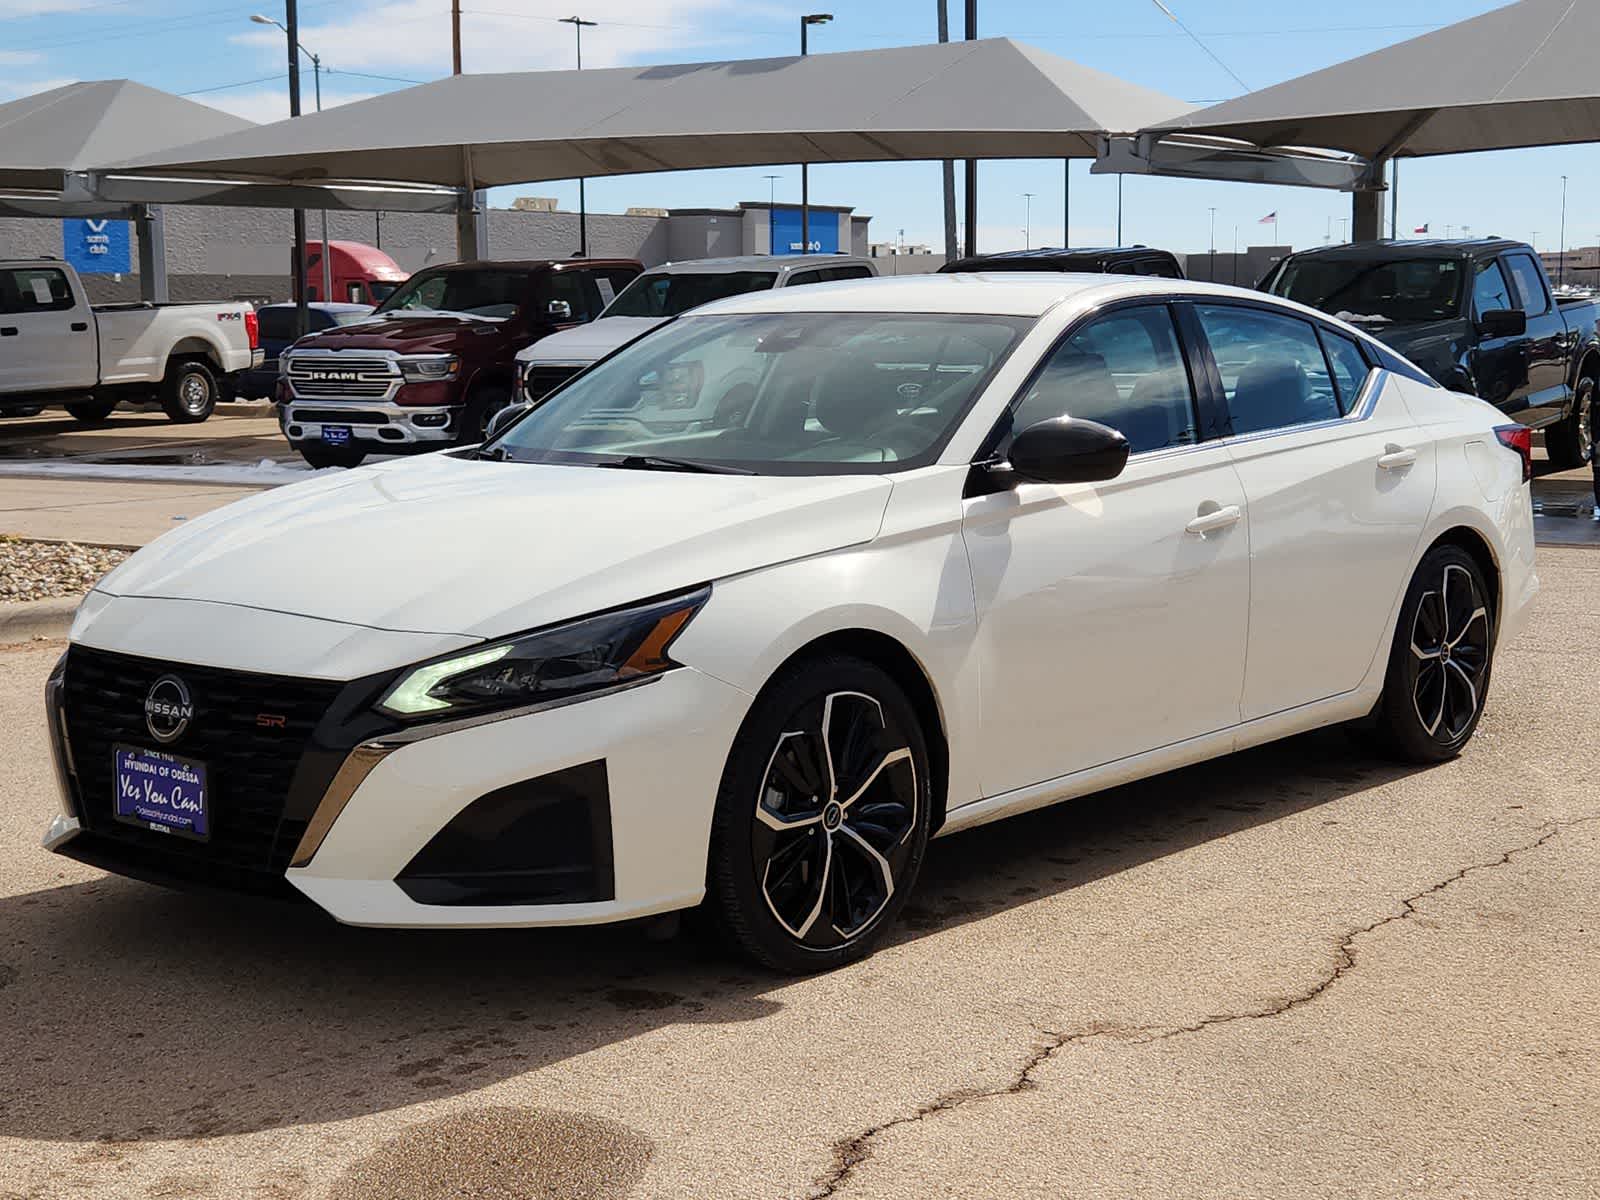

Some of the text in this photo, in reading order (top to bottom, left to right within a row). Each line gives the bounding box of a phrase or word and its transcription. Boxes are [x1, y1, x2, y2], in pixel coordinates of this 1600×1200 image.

[217, 312, 241, 321] FX4
[313, 372, 356, 380] RAM
[145, 699, 193, 718] NISSAN
[256, 713, 286, 728] SR
[124, 759, 200, 785] HYUNDAI OF ODESSA
[121, 774, 204, 814] Yes You Can!
